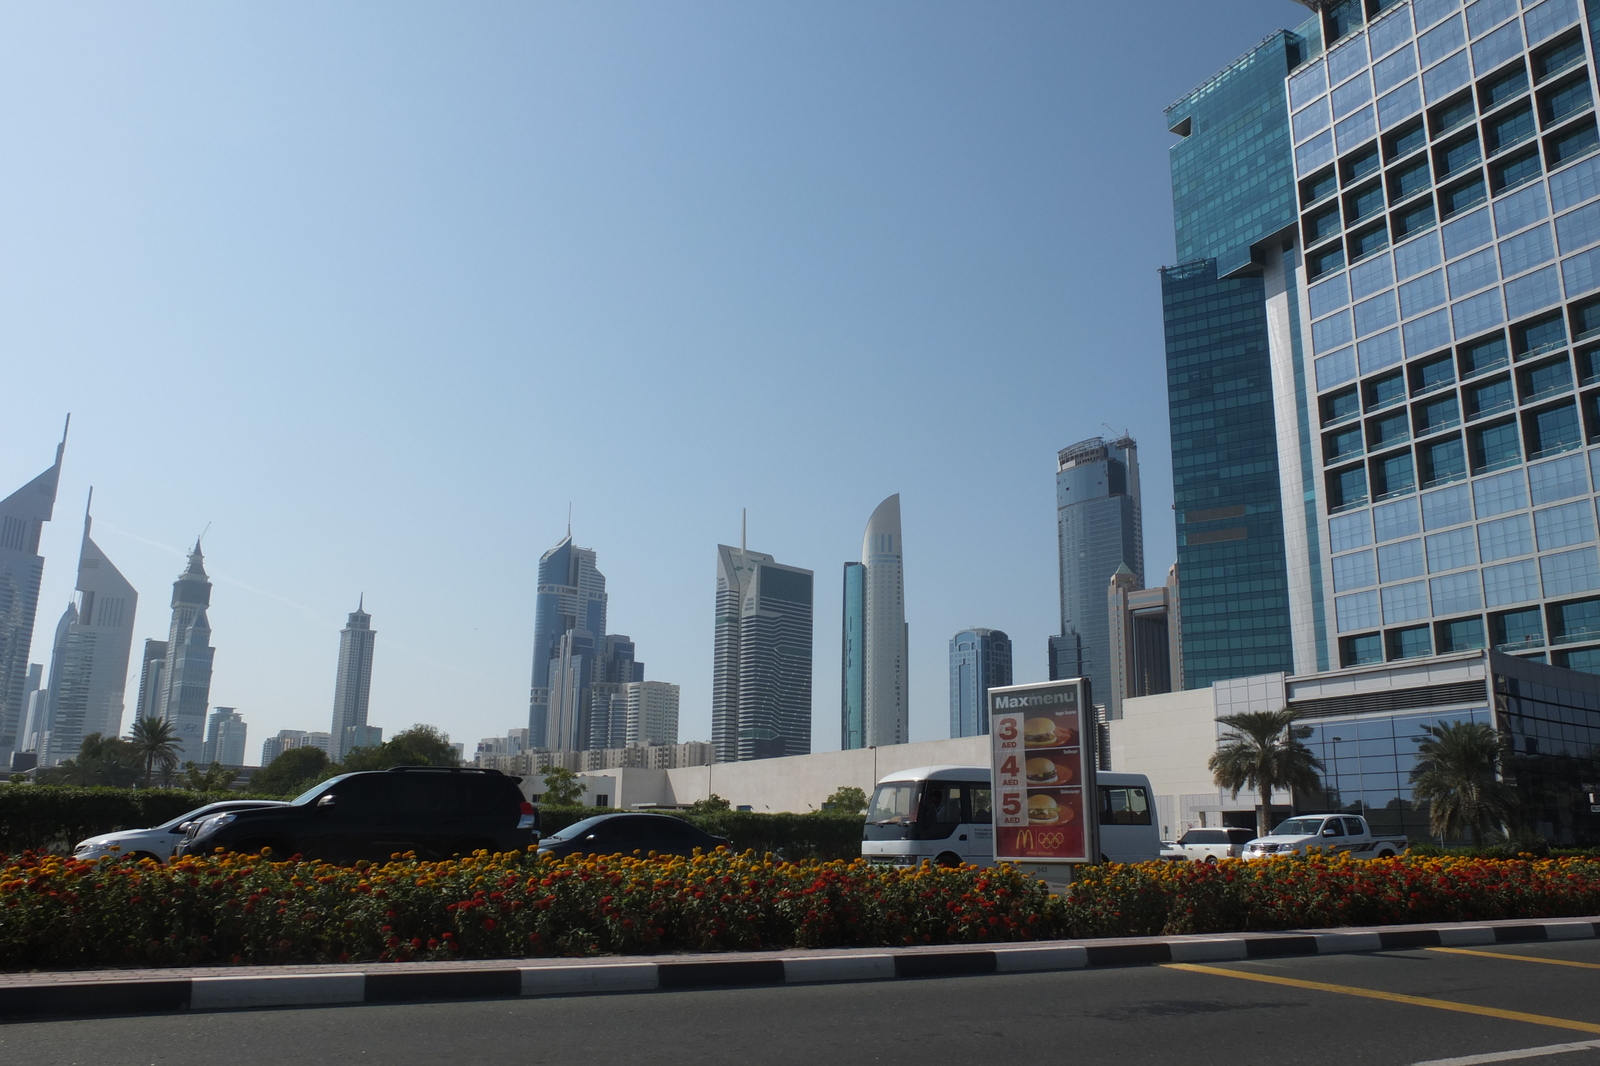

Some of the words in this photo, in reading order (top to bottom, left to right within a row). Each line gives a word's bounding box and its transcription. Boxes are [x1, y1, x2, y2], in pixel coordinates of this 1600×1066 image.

[995, 692, 1075, 709] Maxmenu
[998, 718, 1018, 740] 3
[1000, 755, 1020, 777] 4
[1002, 793, 1022, 815] 5
